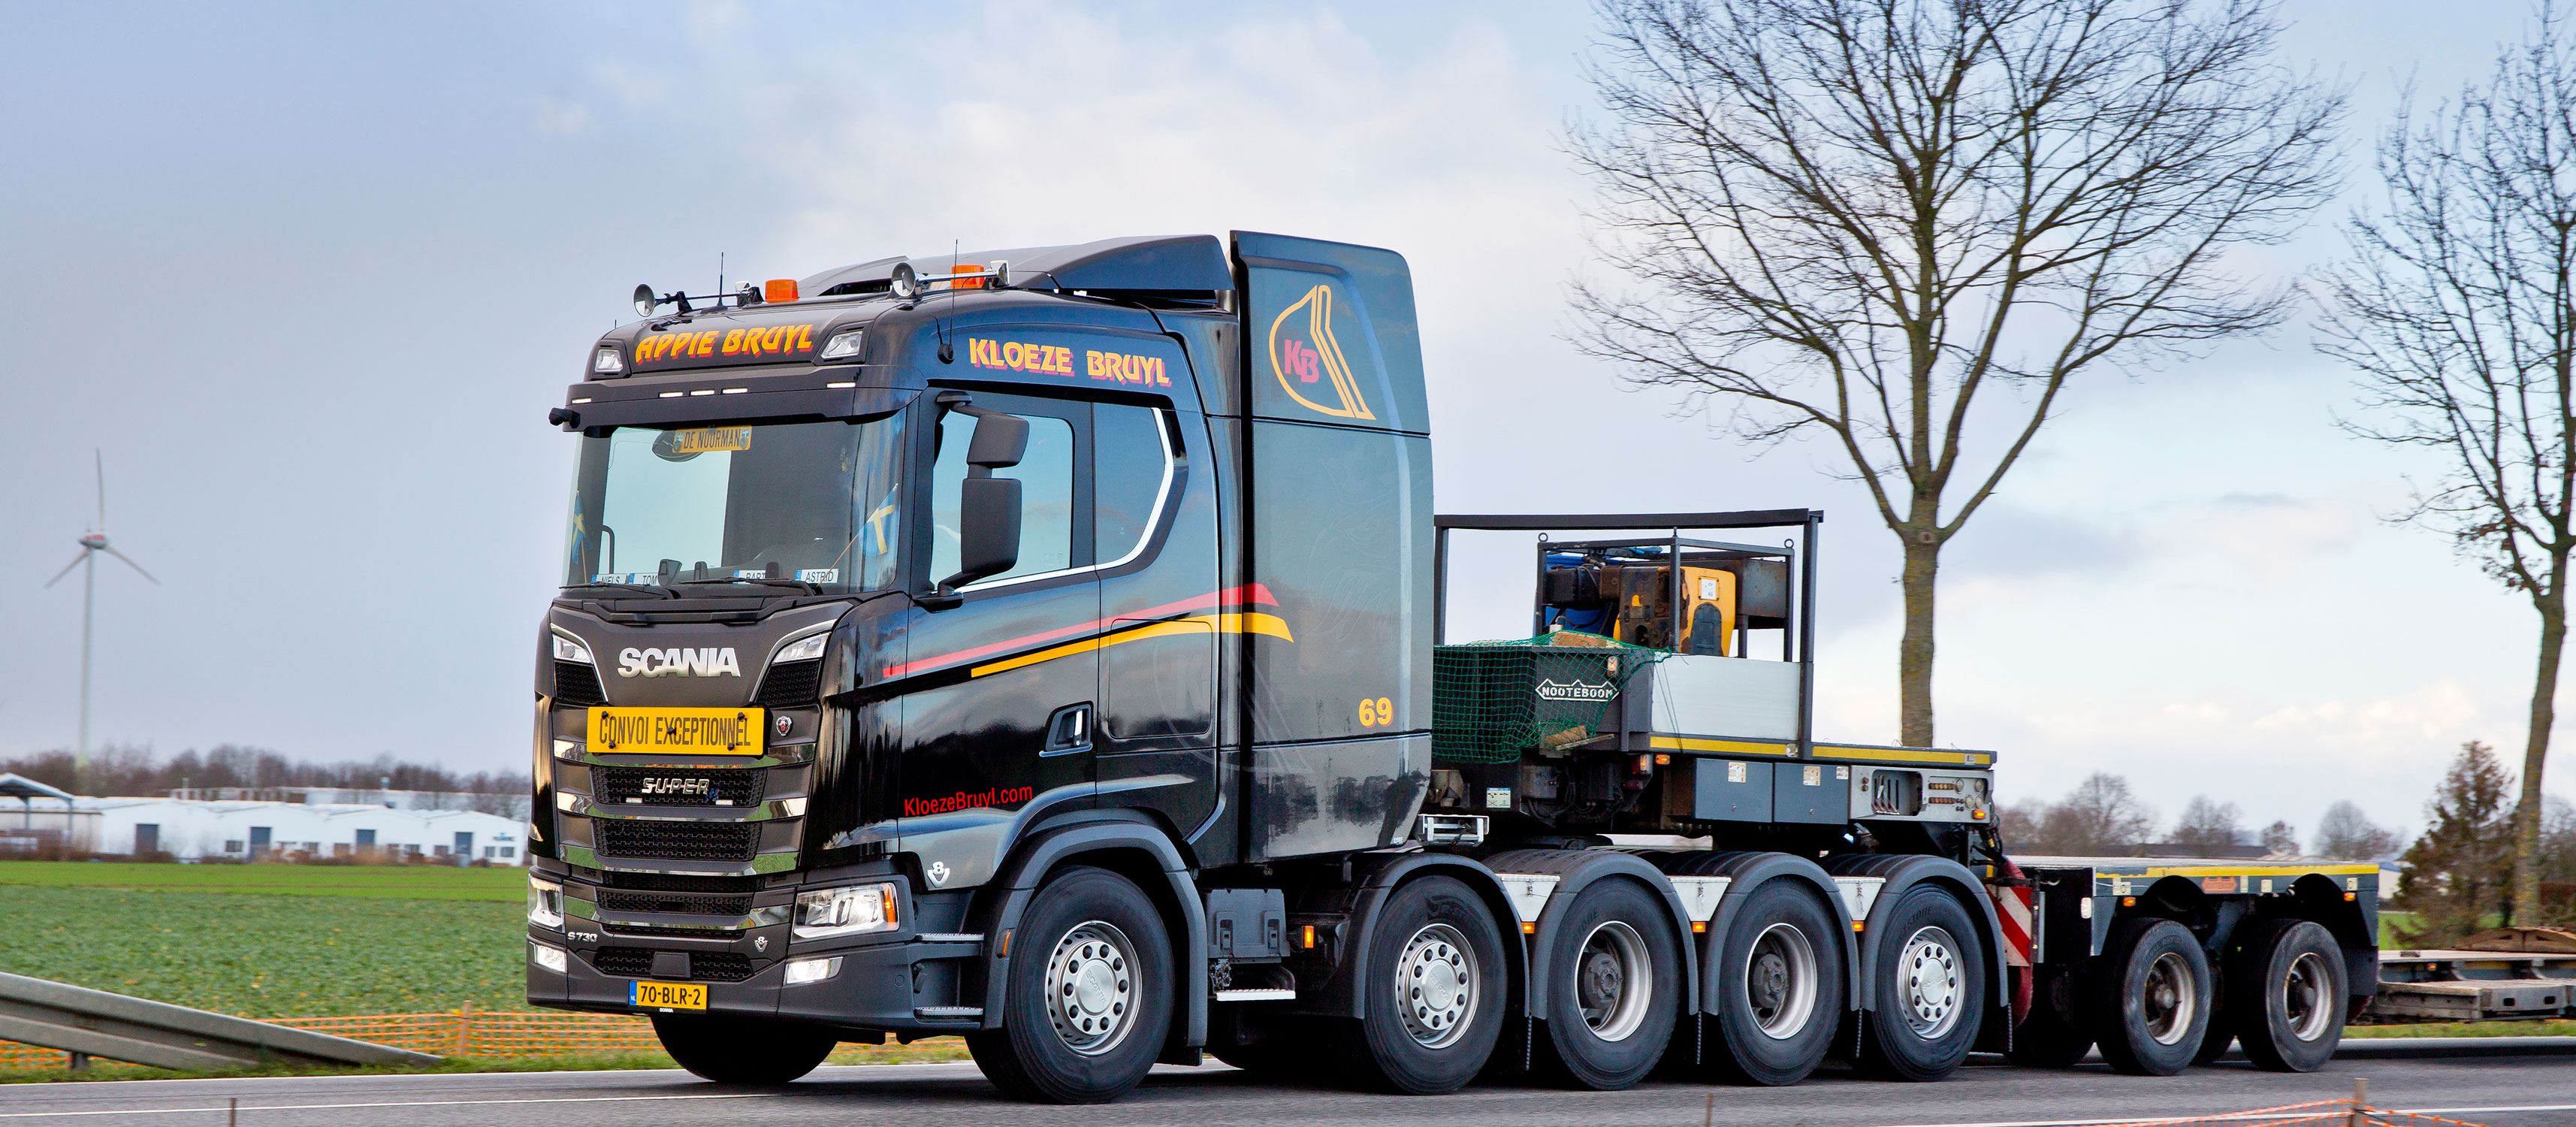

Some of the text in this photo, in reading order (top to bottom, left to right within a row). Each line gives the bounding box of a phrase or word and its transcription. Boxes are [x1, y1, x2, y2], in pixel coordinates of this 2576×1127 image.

[636, 324, 814, 366] APPIE BRUYL
[968, 337, 1173, 388] KLOEZE BRUYL
[1284, 339, 1320, 383] KB
[683, 428, 741, 449] DE NOORMAN
[642, 575, 657, 585] TOM
[805, 571, 834, 582] ASTRID
[617, 647, 741, 678] SCANIA
[1541, 686, 1613, 699] NOOTEBOOM
[1358, 697, 1394, 728] 69
[599, 715, 751, 747] CONVOI EXCEPTIONNEL
[641, 778, 710, 795] SUPER
[904, 786, 1033, 817] KloezeBruyl.com
[640, 985, 701, 1006] 70-BLR-2
